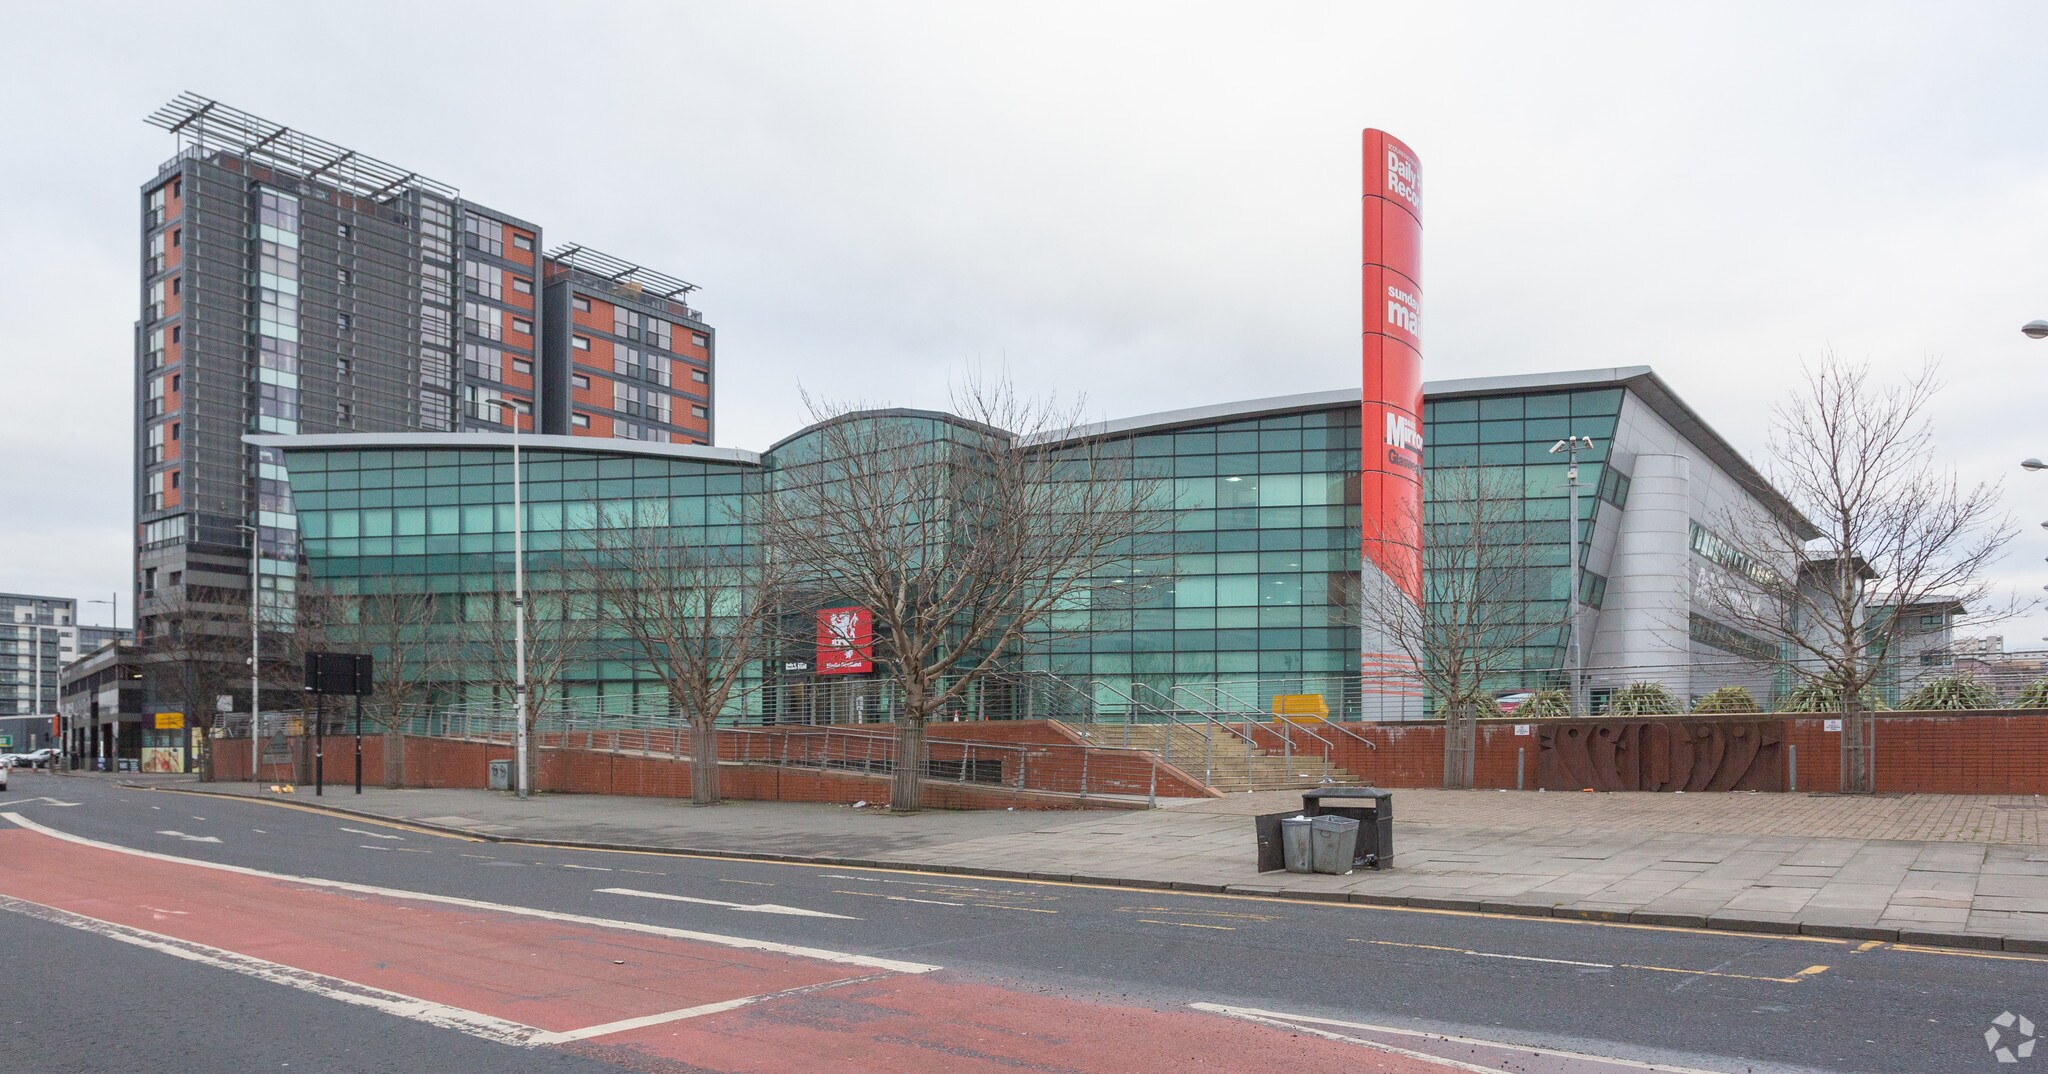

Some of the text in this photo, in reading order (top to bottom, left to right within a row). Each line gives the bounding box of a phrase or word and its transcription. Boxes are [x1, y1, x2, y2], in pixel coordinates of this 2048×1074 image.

[1388, 150, 1416, 190] Daily
[1388, 170, 1422, 209] Recor
[1388, 300, 1421, 339] mai
